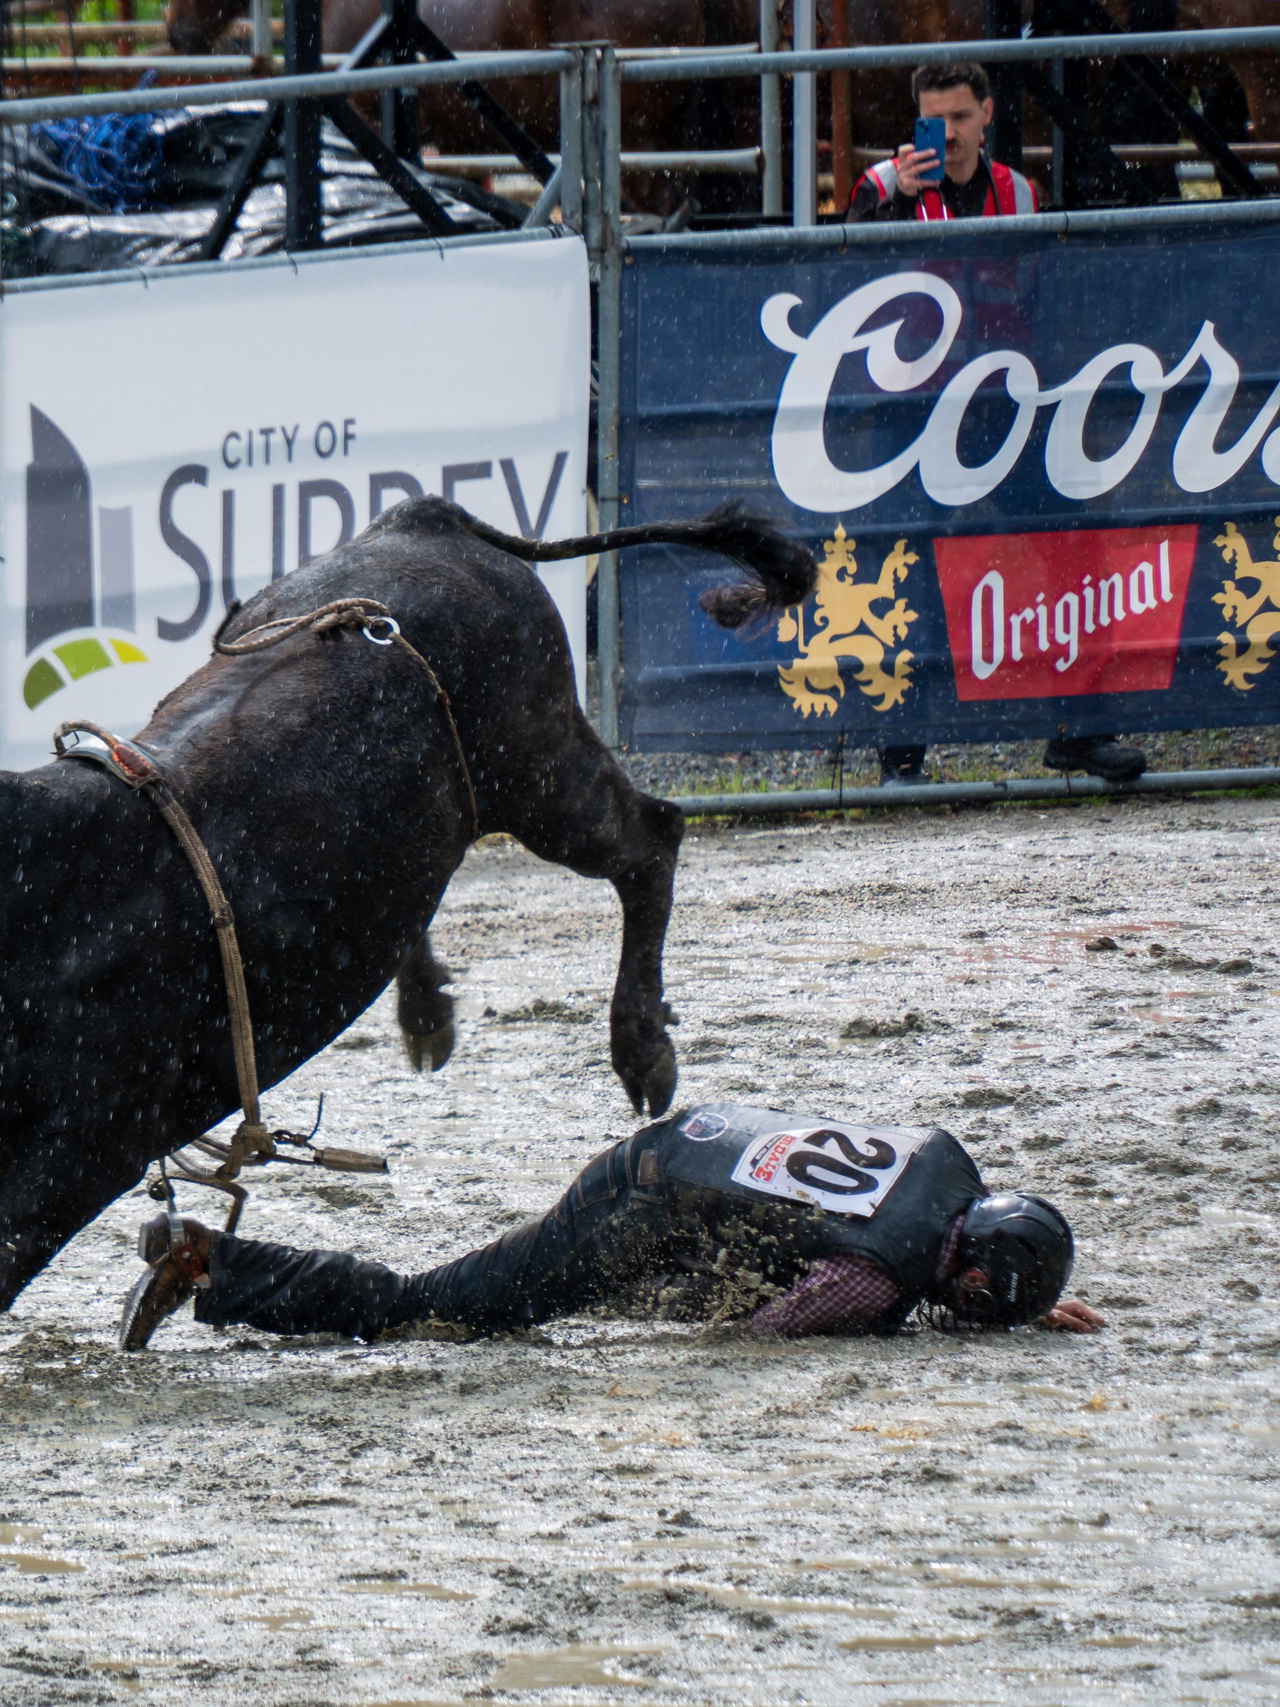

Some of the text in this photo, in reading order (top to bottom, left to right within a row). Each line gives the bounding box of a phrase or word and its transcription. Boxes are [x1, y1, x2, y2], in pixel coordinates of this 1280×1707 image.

[221, 417, 357, 469] CITY OF
[760, 270, 1280, 514] Coor
[970, 538, 1174, 681] Original
[786, 1128, 897, 1196] 20
